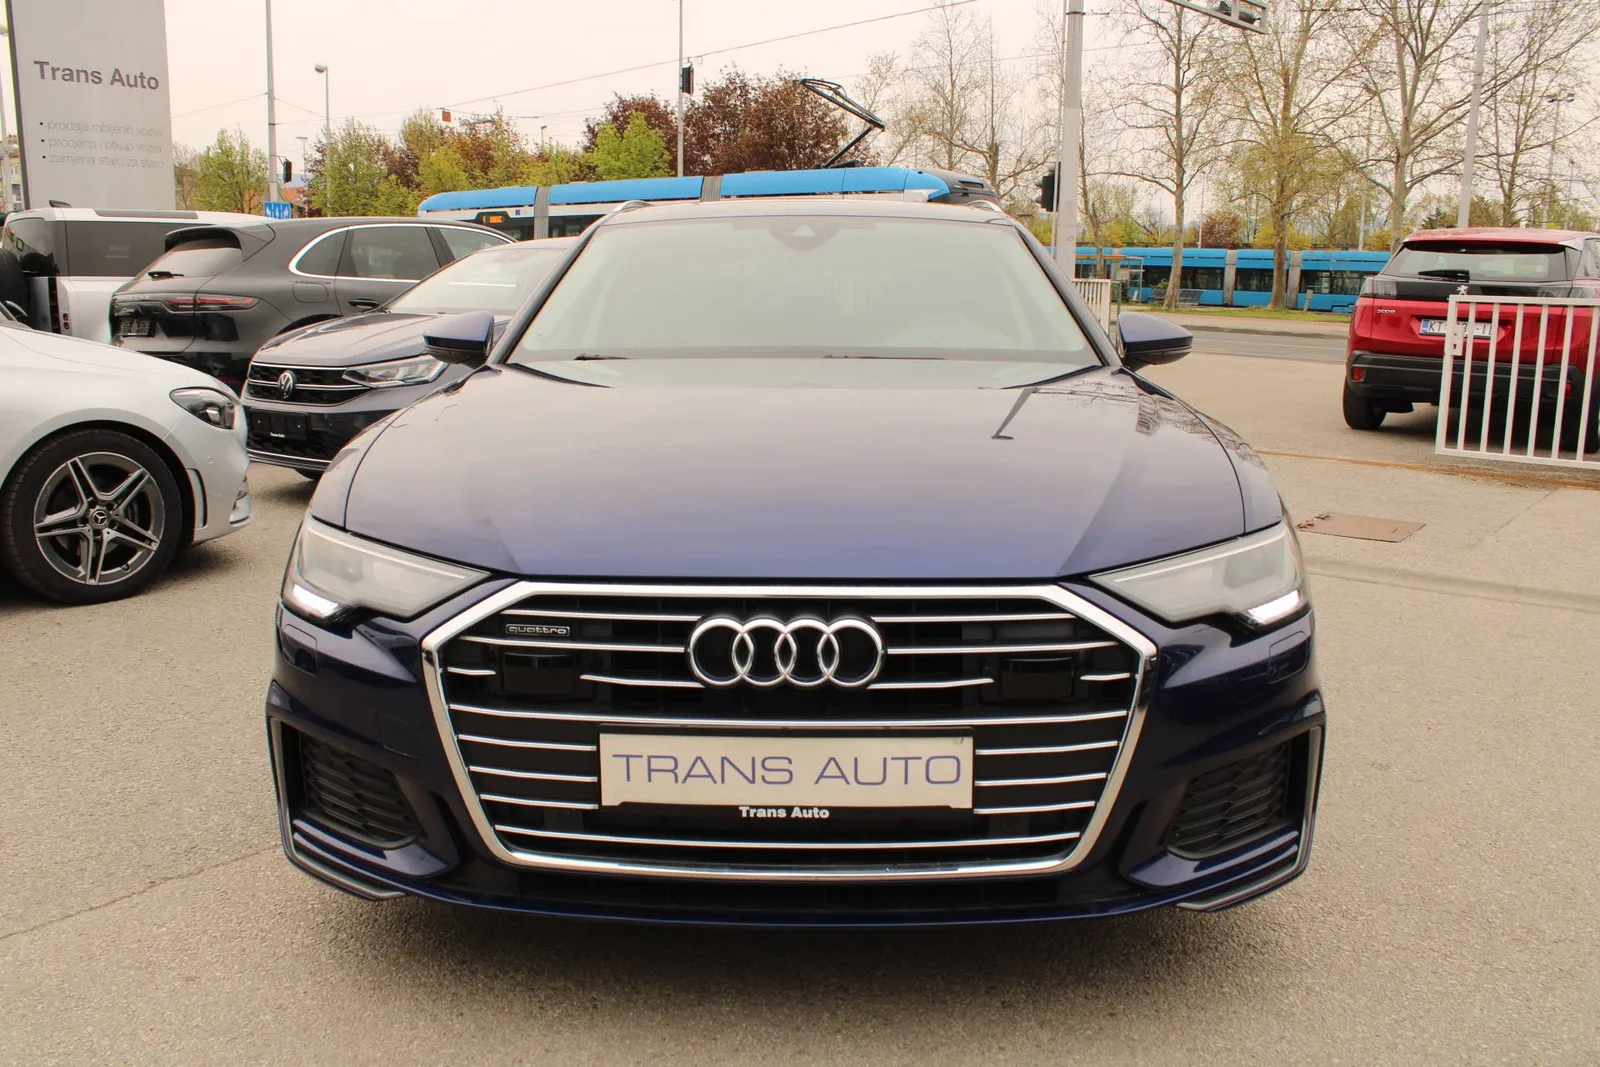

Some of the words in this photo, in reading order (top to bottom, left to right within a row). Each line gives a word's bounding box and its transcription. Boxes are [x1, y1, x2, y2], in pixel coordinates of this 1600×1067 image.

[34, 60, 103, 85] Trans
[110, 68, 159, 90] Auto
[508, 625, 567, 635] quattro
[612, 753, 794, 785] TRANS
[814, 754, 961, 786] AUTO
[739, 806, 786, 819] Trans
[791, 806, 830, 819] Auto
